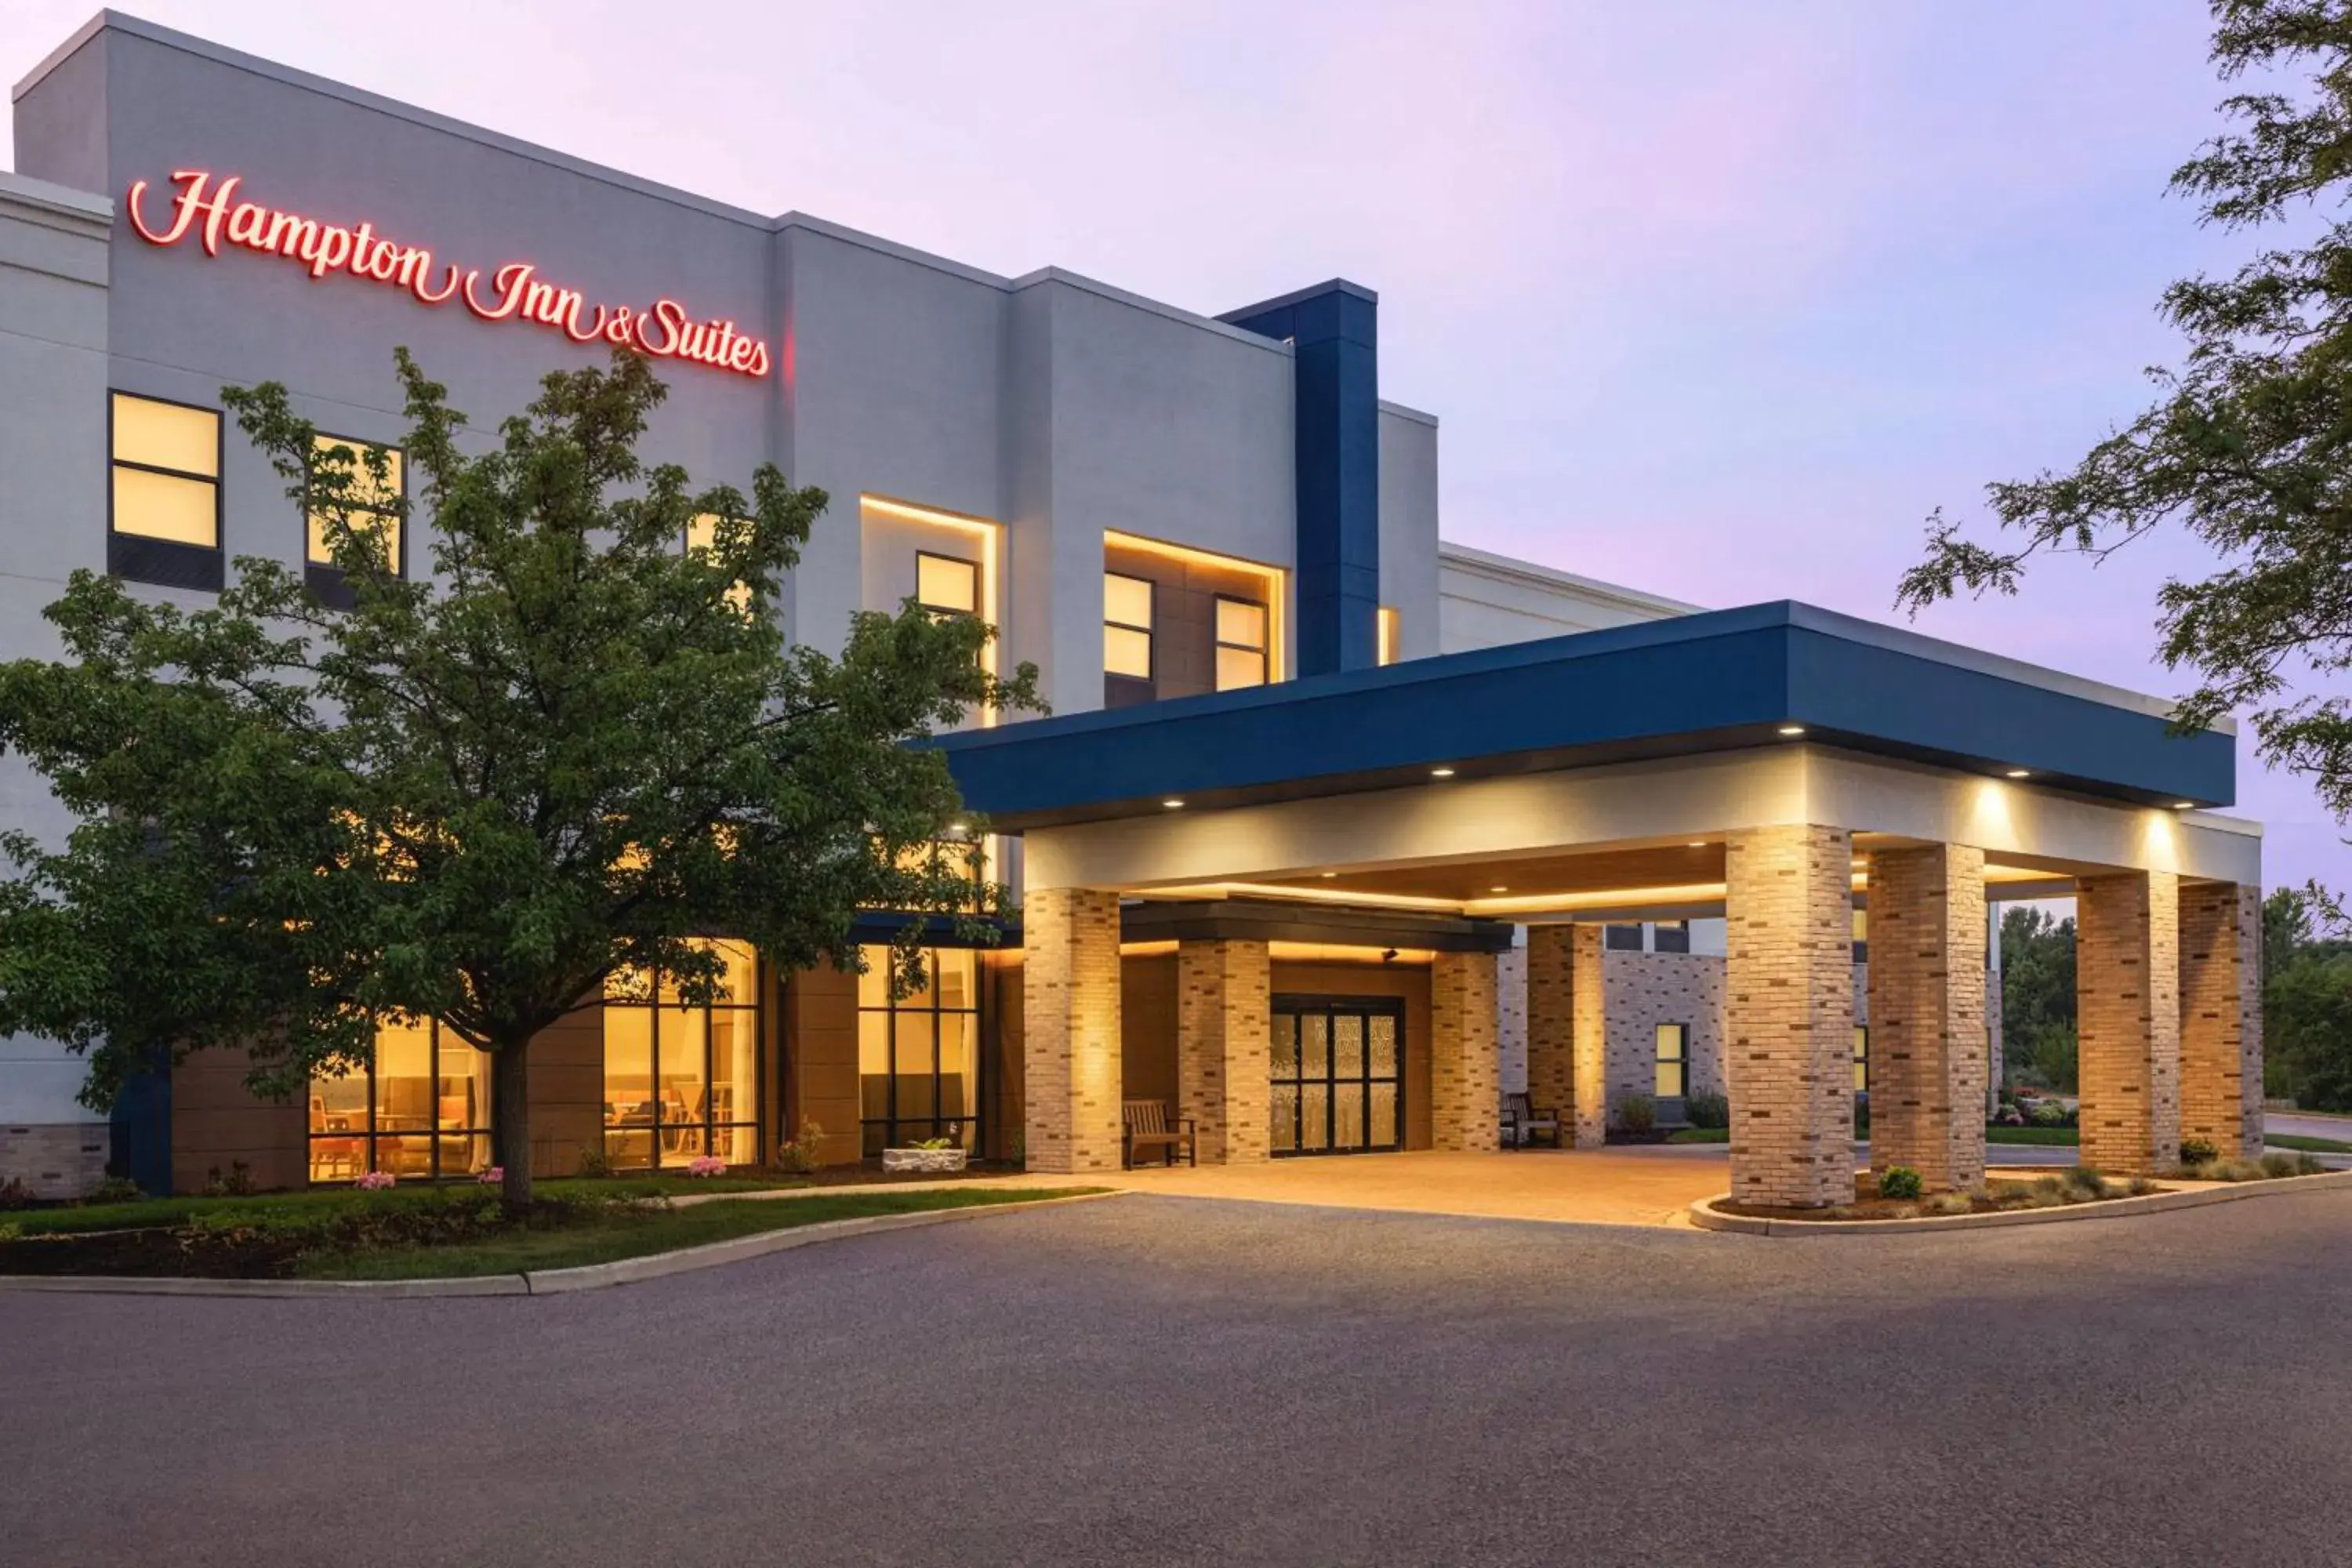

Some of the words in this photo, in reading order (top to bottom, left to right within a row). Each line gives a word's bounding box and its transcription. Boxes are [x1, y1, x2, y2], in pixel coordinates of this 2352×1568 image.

[128, 170, 458, 303] Hampton
[463, 265, 605, 343] Inn
[606, 307, 632, 344] &
[633, 300, 771, 376] Suites
